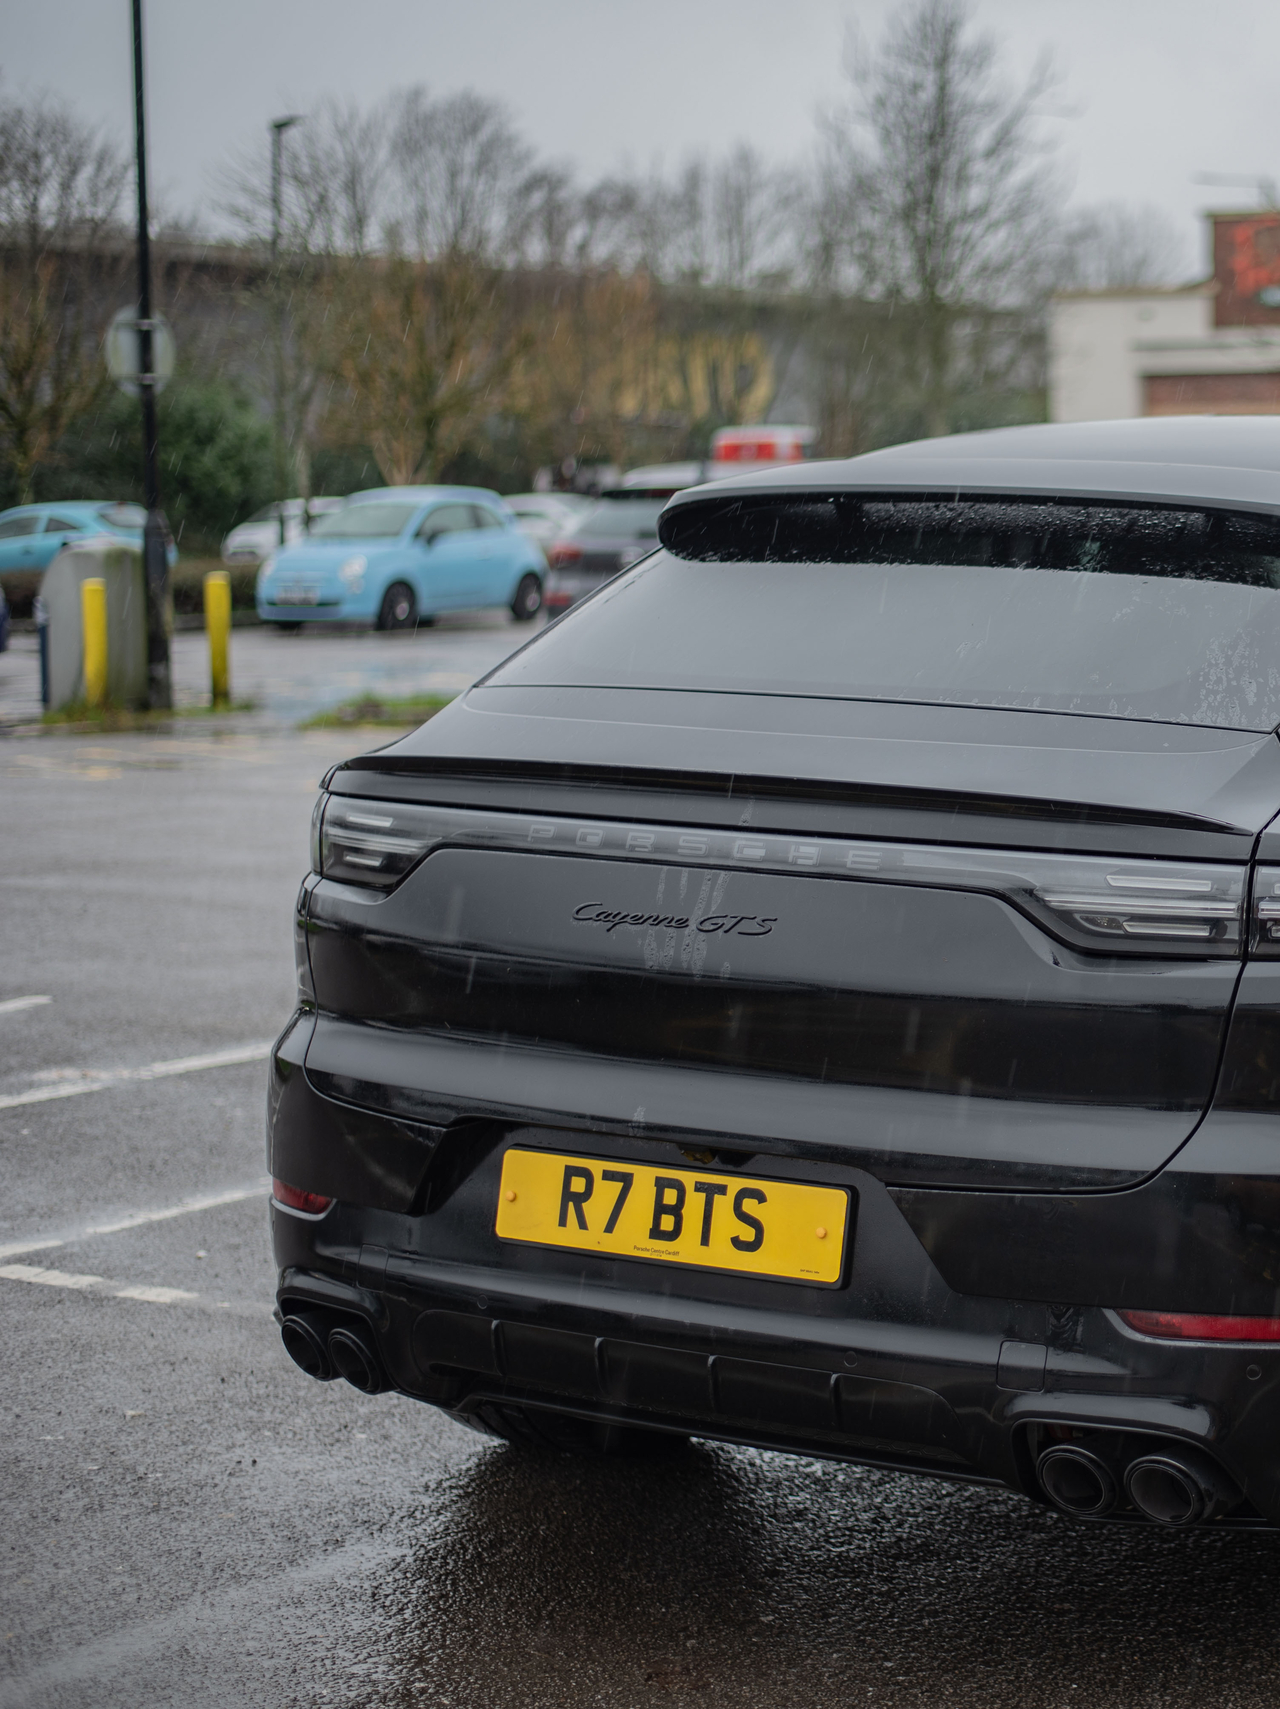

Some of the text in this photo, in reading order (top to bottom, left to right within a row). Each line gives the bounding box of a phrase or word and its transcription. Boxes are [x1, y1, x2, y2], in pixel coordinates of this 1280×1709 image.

[527, 824, 882, 871] PORSCHE
[571, 901, 778, 936] Cayenne GTS
[557, 1164, 768, 1253] R7 BTS
[633, 1244, 650, 1253] Porsche
[651, 1247, 665, 1255] Centre
[665, 1249, 680, 1257] Cardiff
